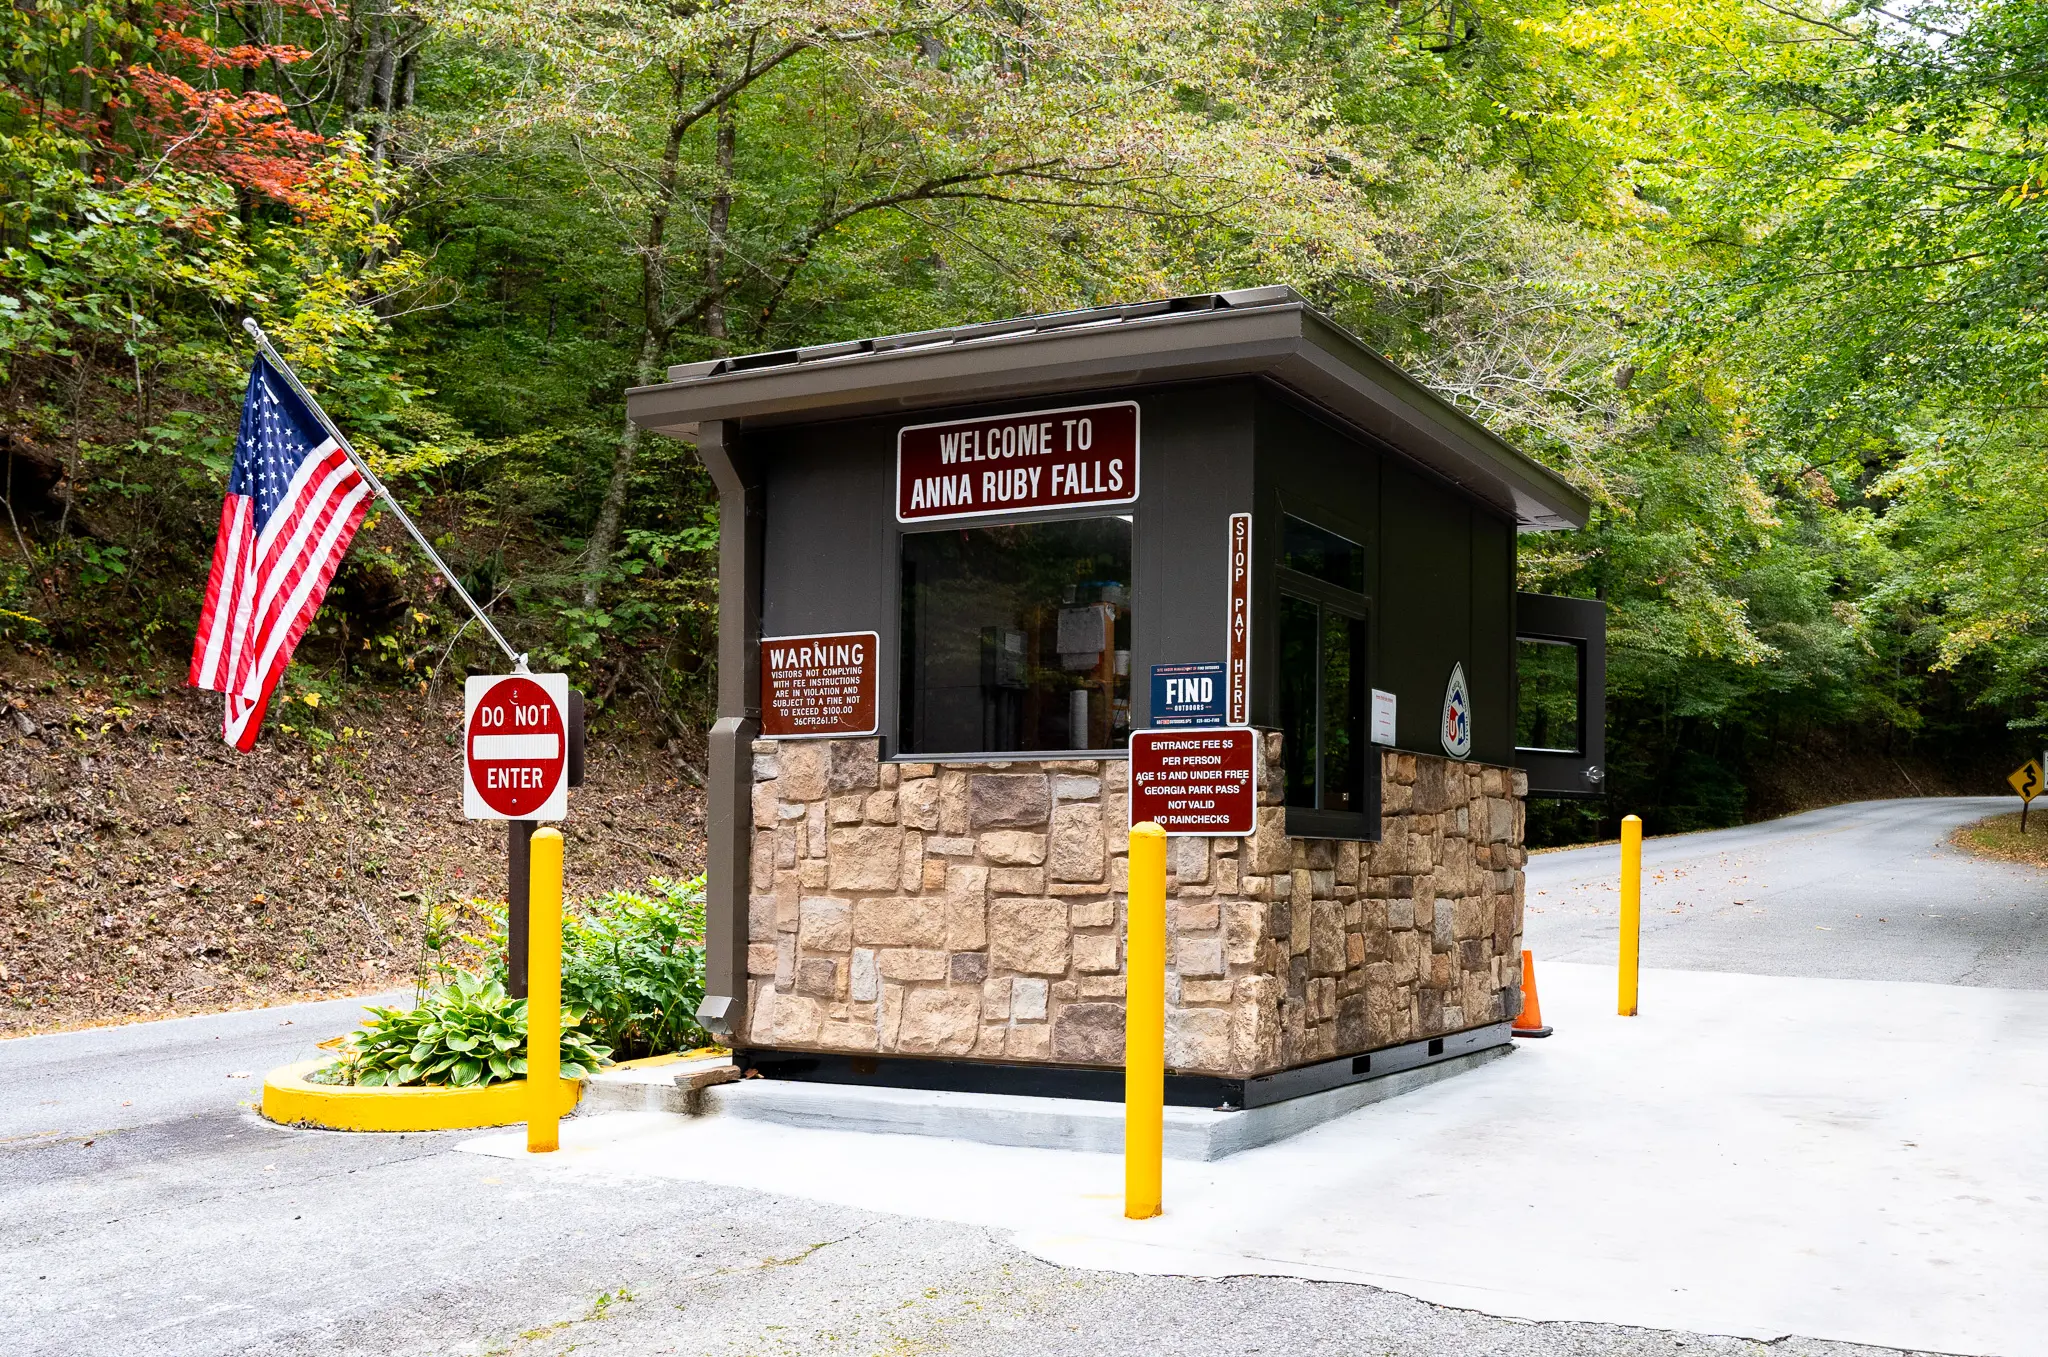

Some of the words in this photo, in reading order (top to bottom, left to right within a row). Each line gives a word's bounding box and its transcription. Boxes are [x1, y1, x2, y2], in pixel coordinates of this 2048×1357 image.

[940, 422, 1052, 464] WELCOME
[1063, 418, 1092, 451] TO
[911, 474, 972, 509] ANNA
[983, 467, 1041, 503] RUBY
[1052, 459, 1123, 496] FALLS
[1235, 522, 1244, 582] STOP
[1235, 598, 1244, 642] PAY
[770, 644, 863, 669] WARNING
[771, 670, 802, 678] VISITORS
[823, 667, 862, 676] COMPLYING
[810, 677, 860, 686] INSTRUCTIONS
[804, 688, 839, 696] VIOLATION
[1166, 678, 1212, 704] FIND
[1234, 659, 1243, 719] HERE
[773, 699, 803, 707] SUBJECT
[823, 706, 852, 714] $100.00
[482, 706, 504, 727] DO
[516, 705, 550, 726] NOT
[794, 716, 838, 726] 36CFR261.15
[1151, 741, 1200, 750] ENTRANCE
[1202, 740, 1220, 748] FEE
[1222, 740, 1233, 748] $5
[1162, 757, 1180, 765] PER
[1183, 756, 1221, 765] PERSON
[488, 768, 543, 789] ENTER
[1136, 772, 1154, 781] AGE
[1169, 772, 1188, 780] AND
[1190, 771, 1222, 779] UNDER
[1225, 770, 1249, 778] FREE
[1145, 786, 1186, 795] GEORGIA
[1188, 786, 1213, 794] PARK
[1216, 785, 1240, 794] PASS
[1168, 801, 1186, 809] NOT
[1170, 815, 1229, 824] RAINCHECKS
